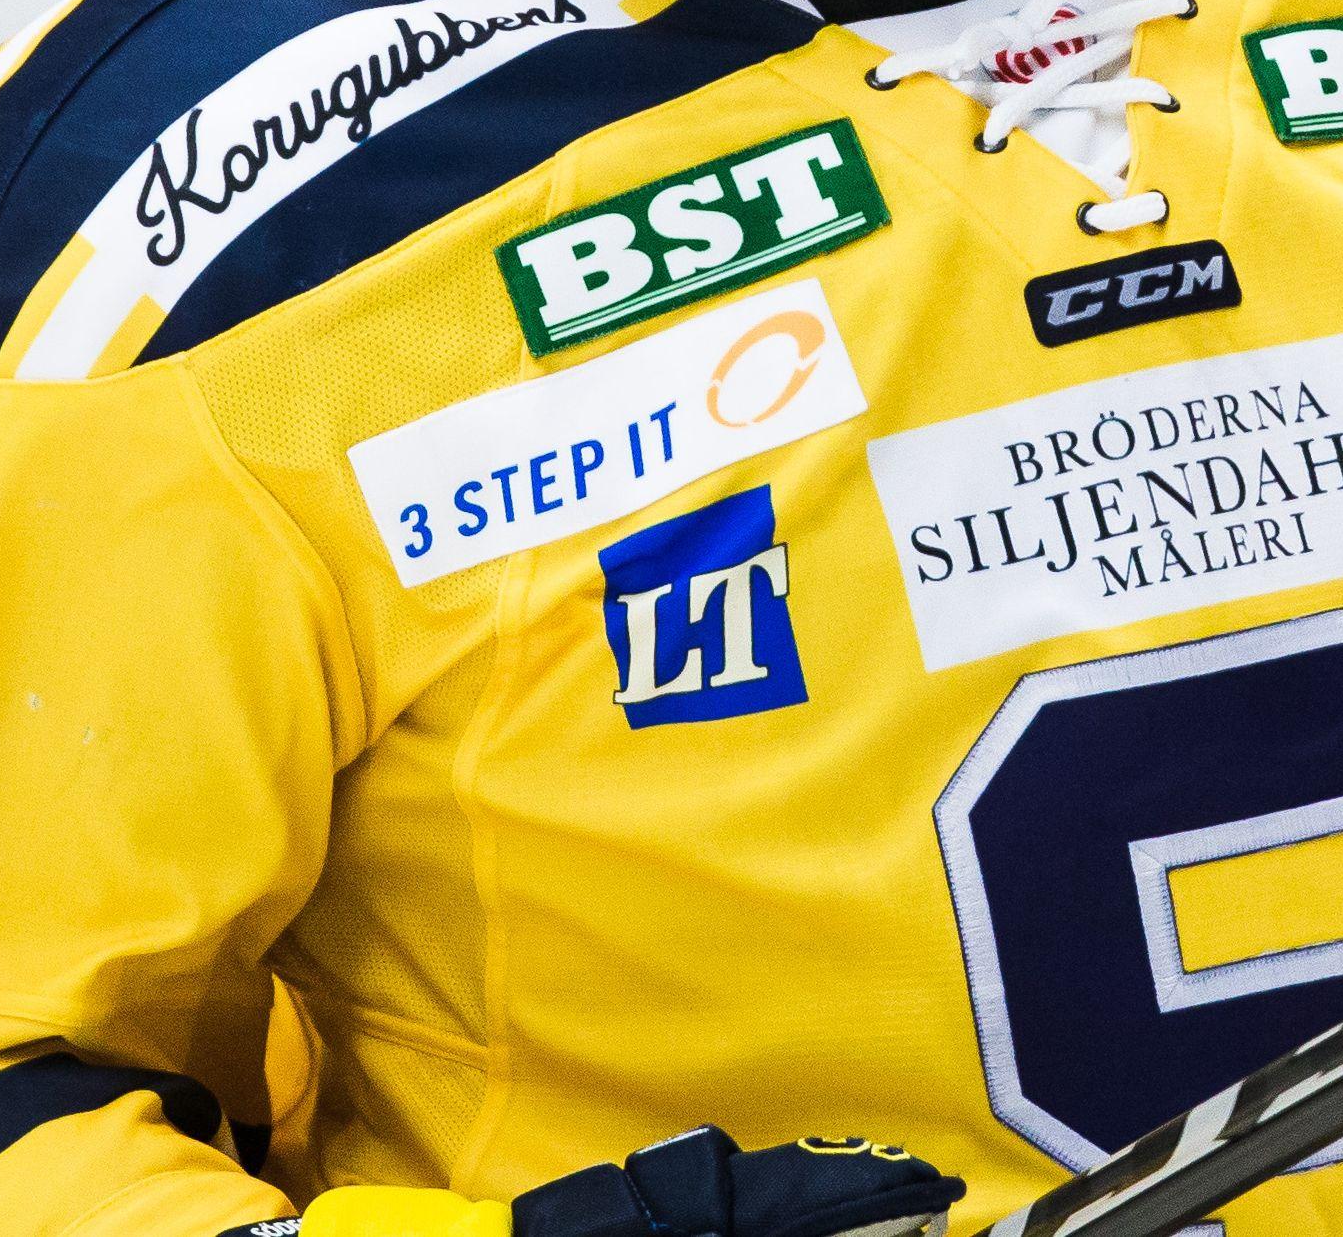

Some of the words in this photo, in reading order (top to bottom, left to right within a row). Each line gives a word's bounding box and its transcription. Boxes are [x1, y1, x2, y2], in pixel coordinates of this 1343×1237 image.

[516, 133, 843, 328] BST
[1046, 255, 1223, 327] CCM
[400, 503, 433, 559] 3
[454, 439, 604, 537] STEP
[628, 402, 677, 479] IT
[1005, 381, 1330, 486] BRÖDERNA
[1093, 512, 1314, 597] MÅLERI
[613, 543, 788, 705] LT
